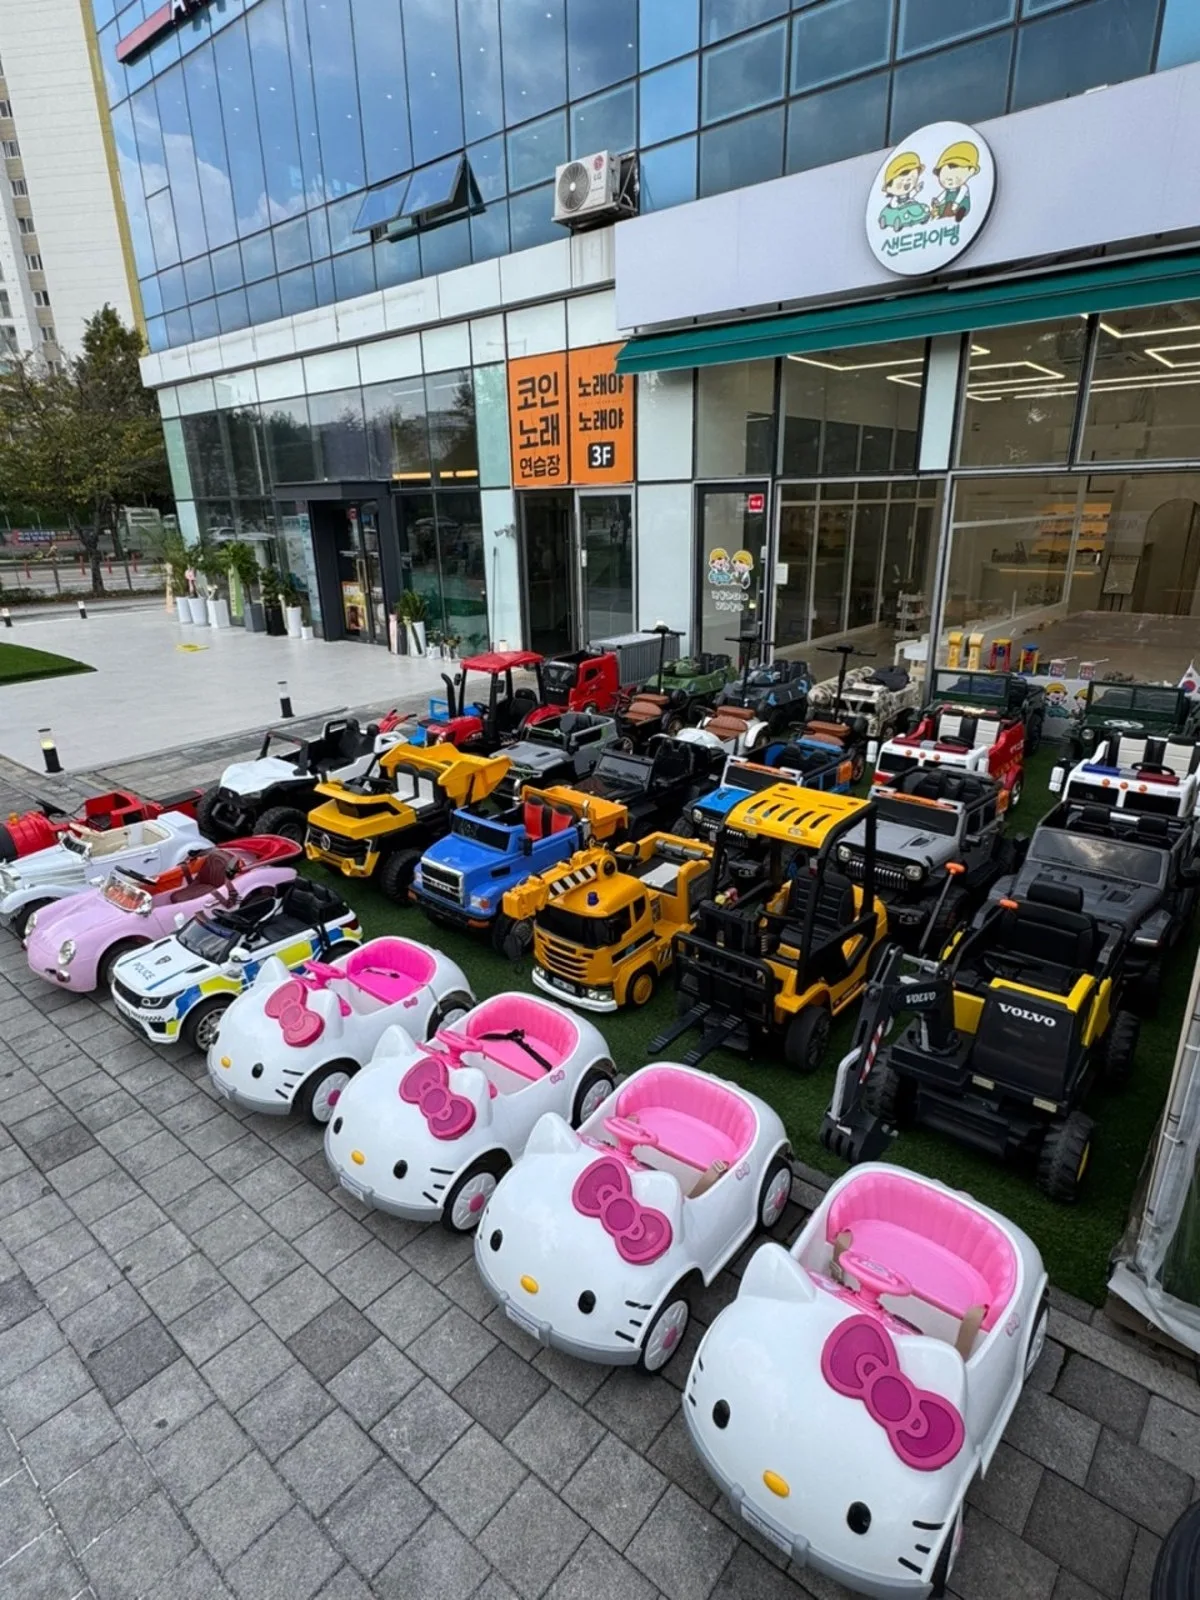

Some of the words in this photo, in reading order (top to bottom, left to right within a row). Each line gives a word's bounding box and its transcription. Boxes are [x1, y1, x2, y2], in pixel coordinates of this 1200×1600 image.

[517, 371, 560, 411] 코인
[578, 373, 624, 398] 노래야
[519, 413, 560, 450] 노래
[578, 408, 624, 432] 노래야
[519, 454, 561, 479] 연습장
[591, 445, 611, 466] 3F
[133, 962, 155, 980] POLICE
[998, 1002, 1057, 1028] VOLVO
